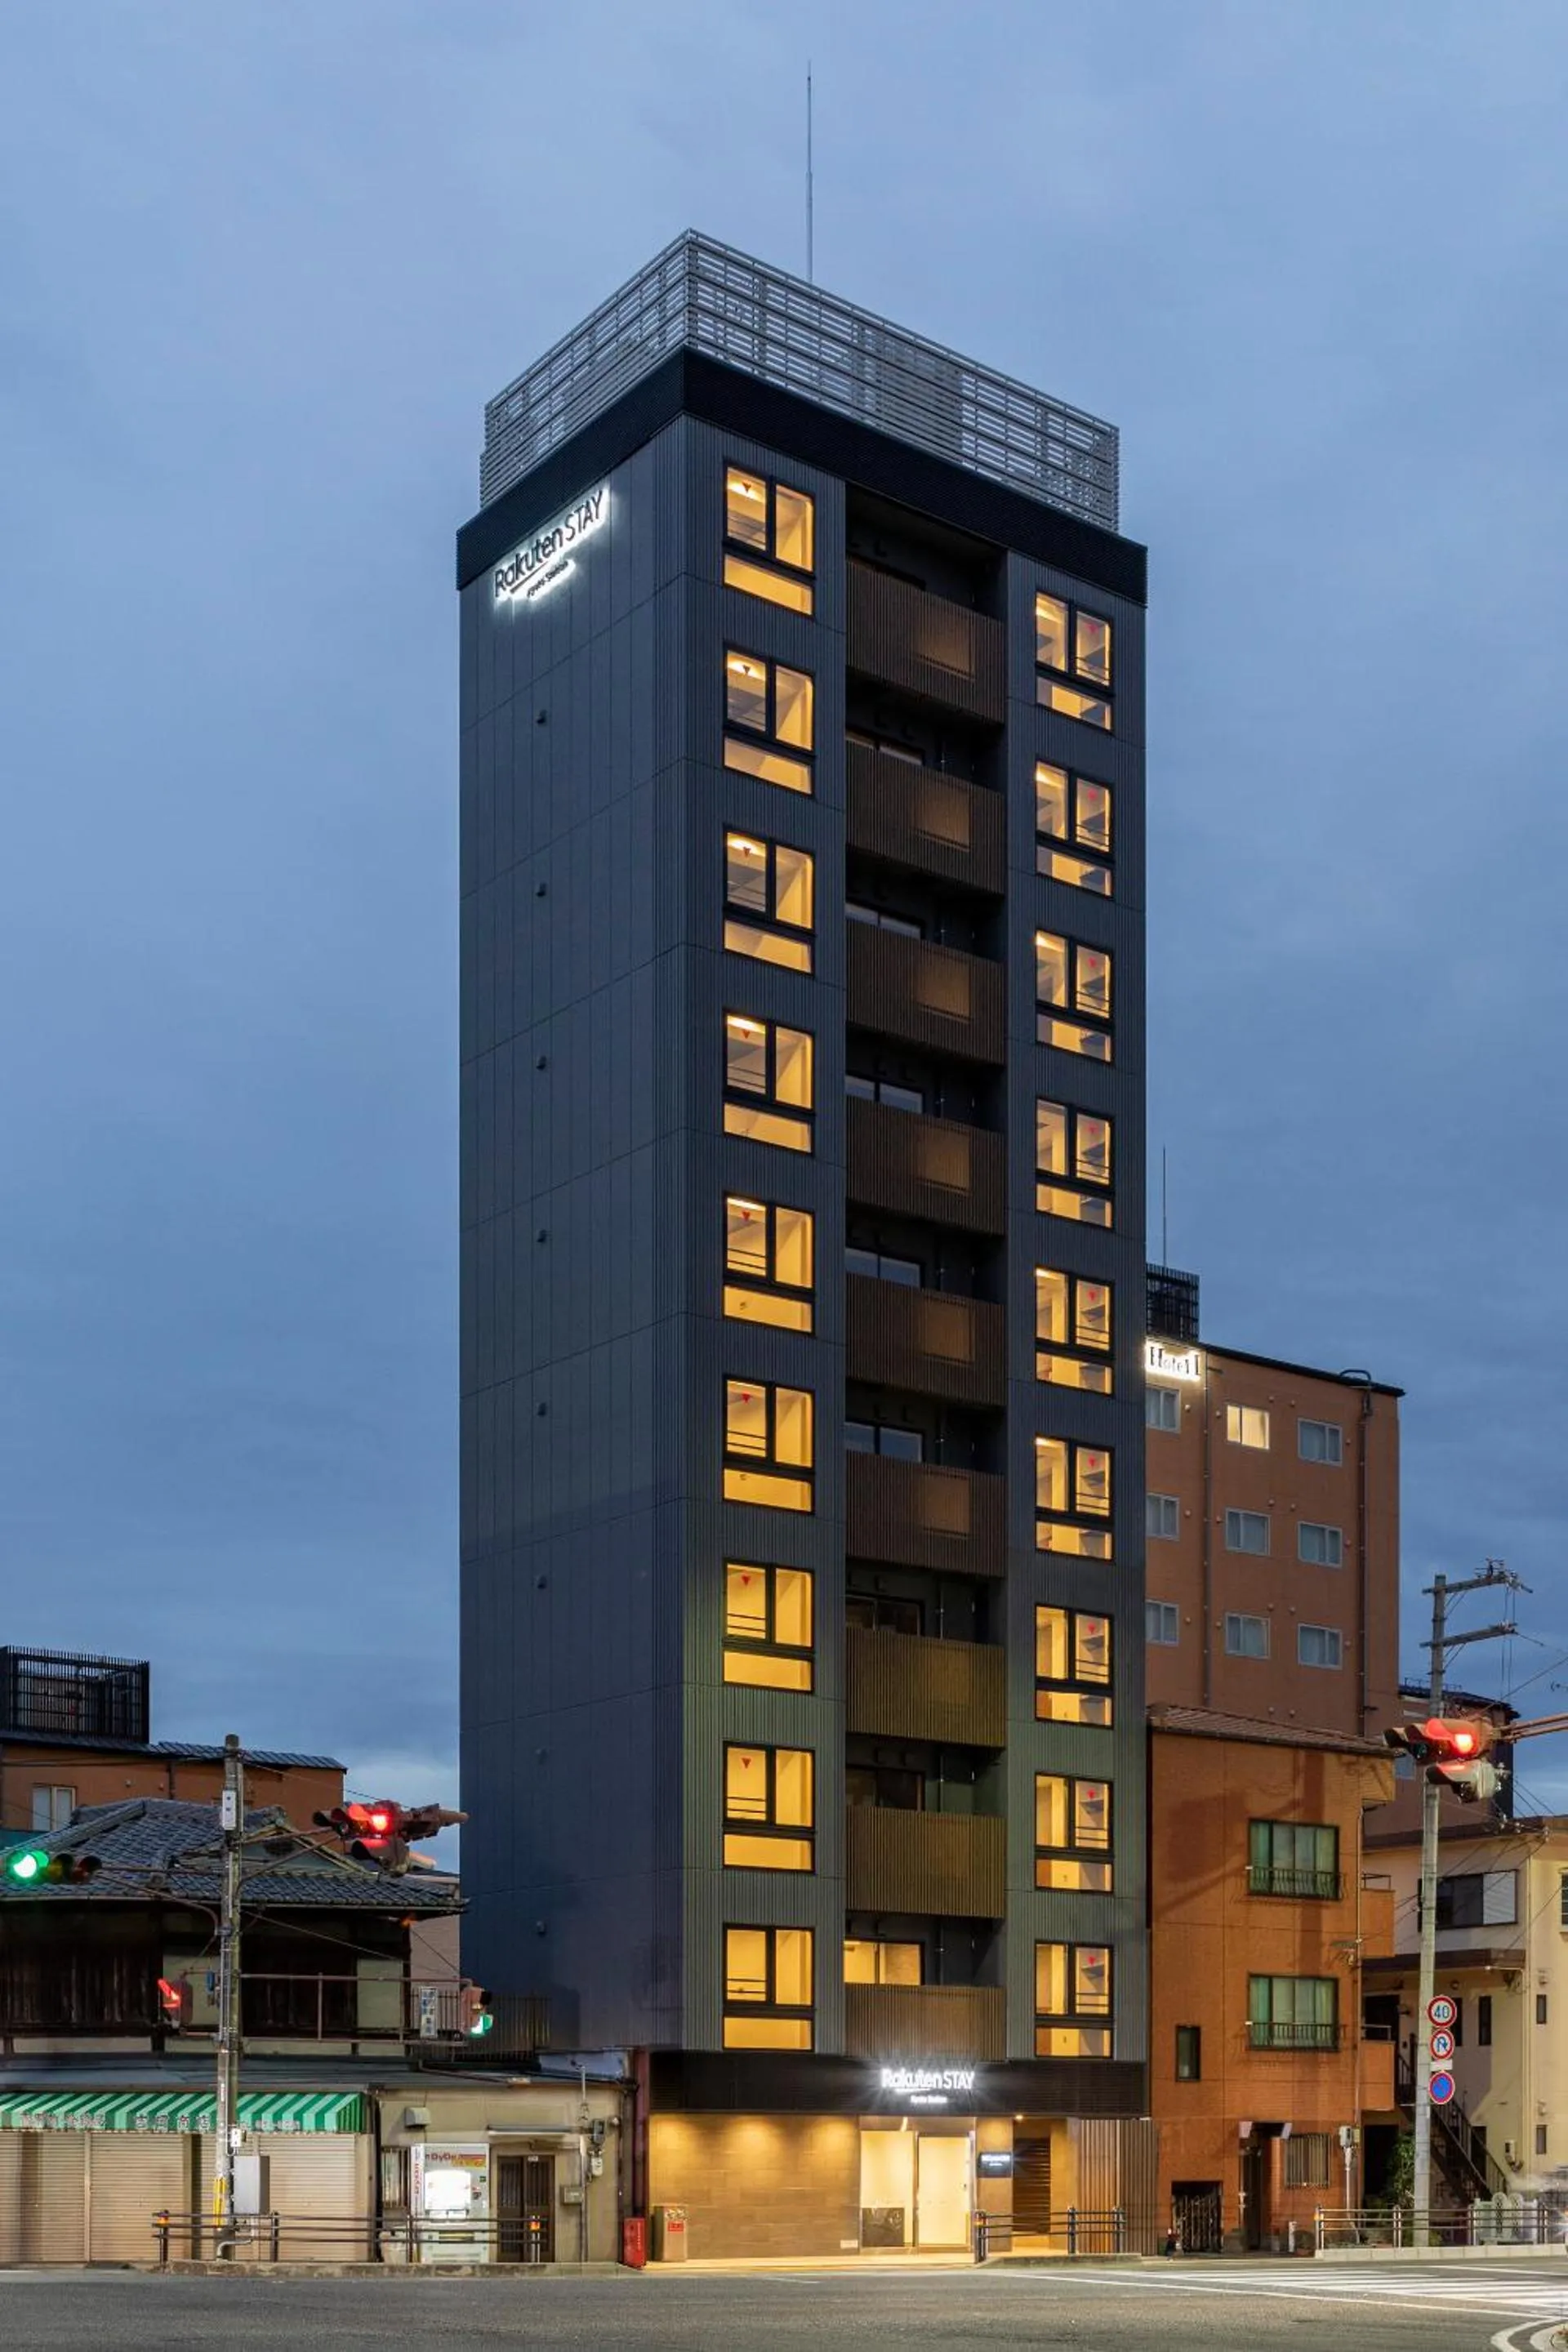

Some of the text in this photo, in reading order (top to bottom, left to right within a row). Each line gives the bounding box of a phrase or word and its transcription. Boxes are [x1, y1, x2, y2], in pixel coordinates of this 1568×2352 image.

[495, 489, 603, 598] Rakuten STAY
[1434, 2005, 1450, 2019] 40
[882, 2067, 975, 2089] Rakuten STAY
